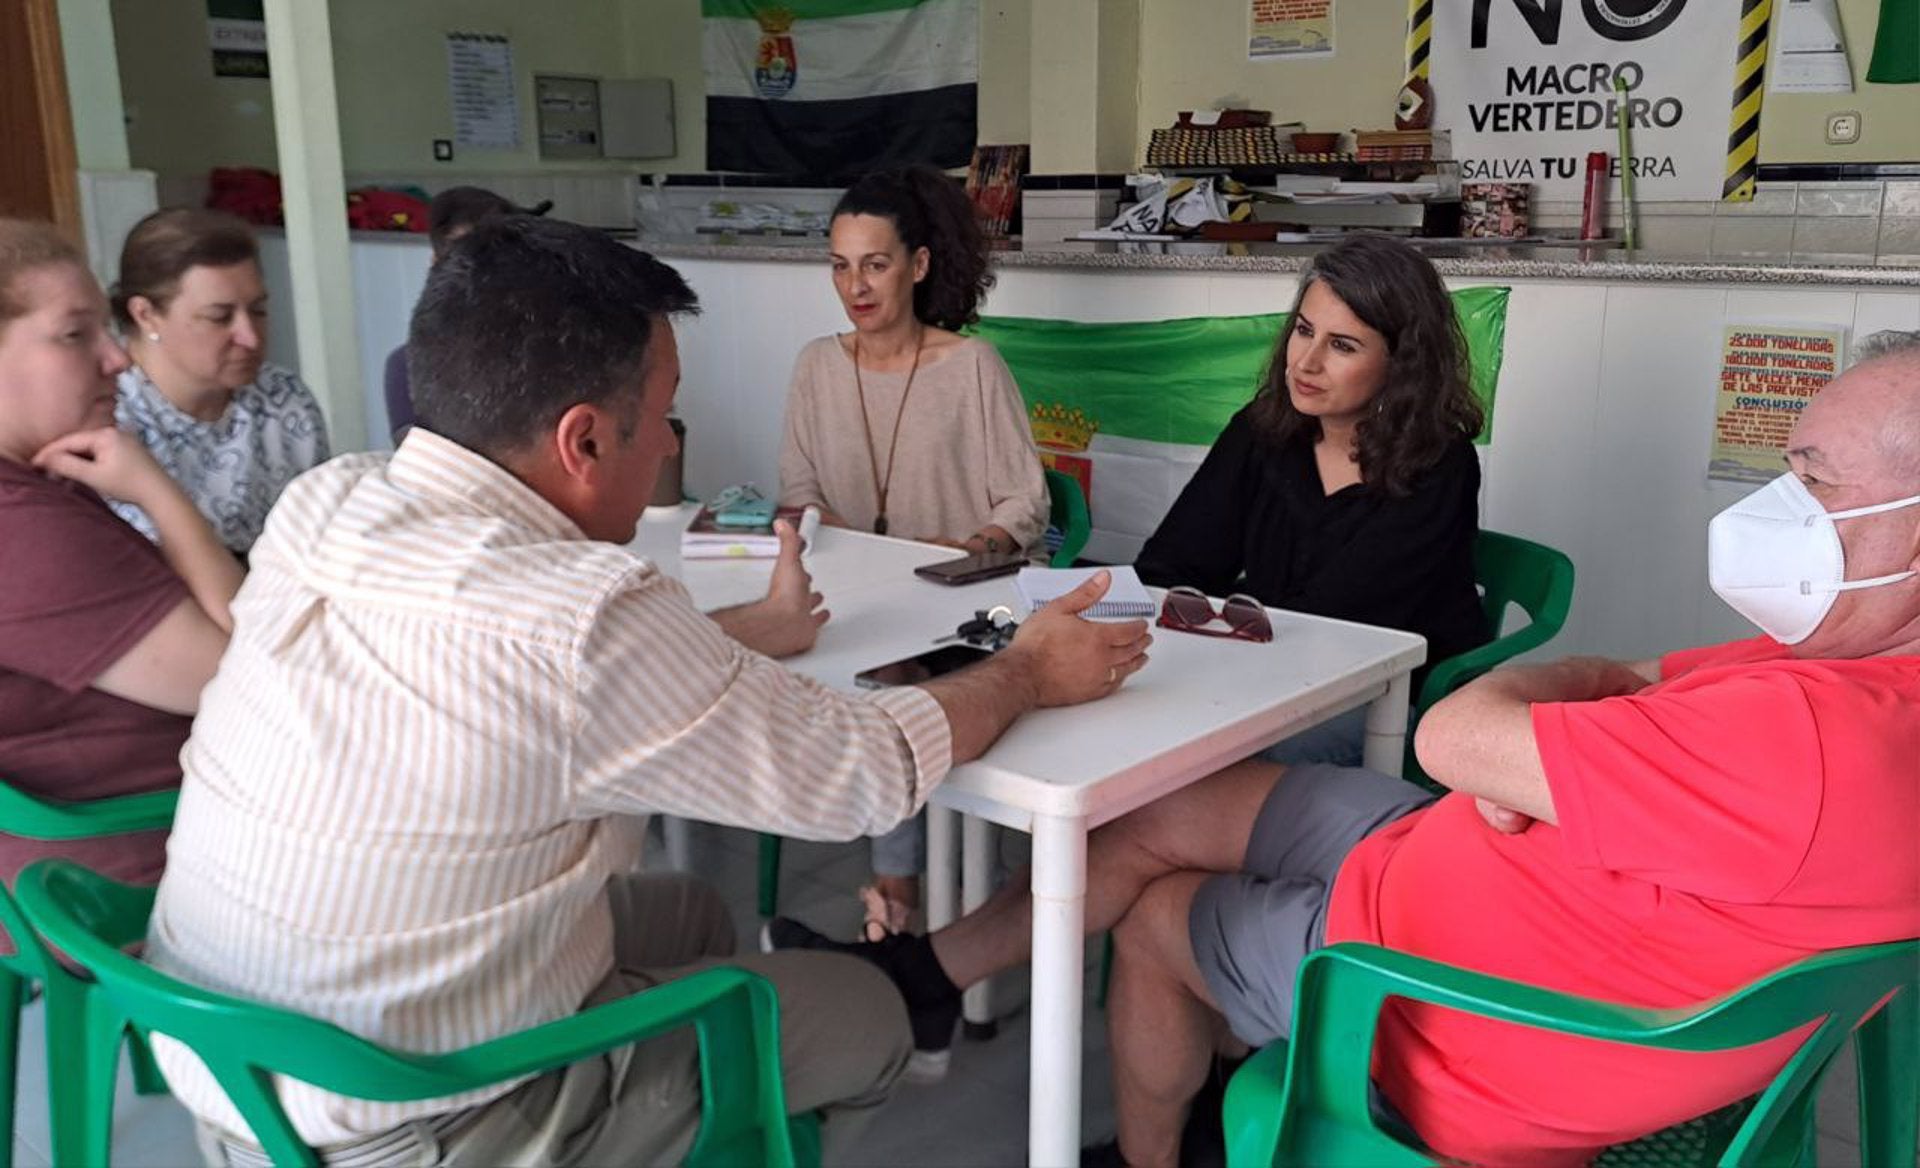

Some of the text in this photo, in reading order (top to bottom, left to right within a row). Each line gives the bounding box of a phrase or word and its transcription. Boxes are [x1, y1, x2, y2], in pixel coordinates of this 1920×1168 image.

[1506, 61, 1643, 96] MACRO
[1468, 97, 1683, 132] VERTEDERO
[1462, 156, 1676, 179] SALVA TU ERRA
[1723, 381, 1820, 397] DE LAS PREVIST
